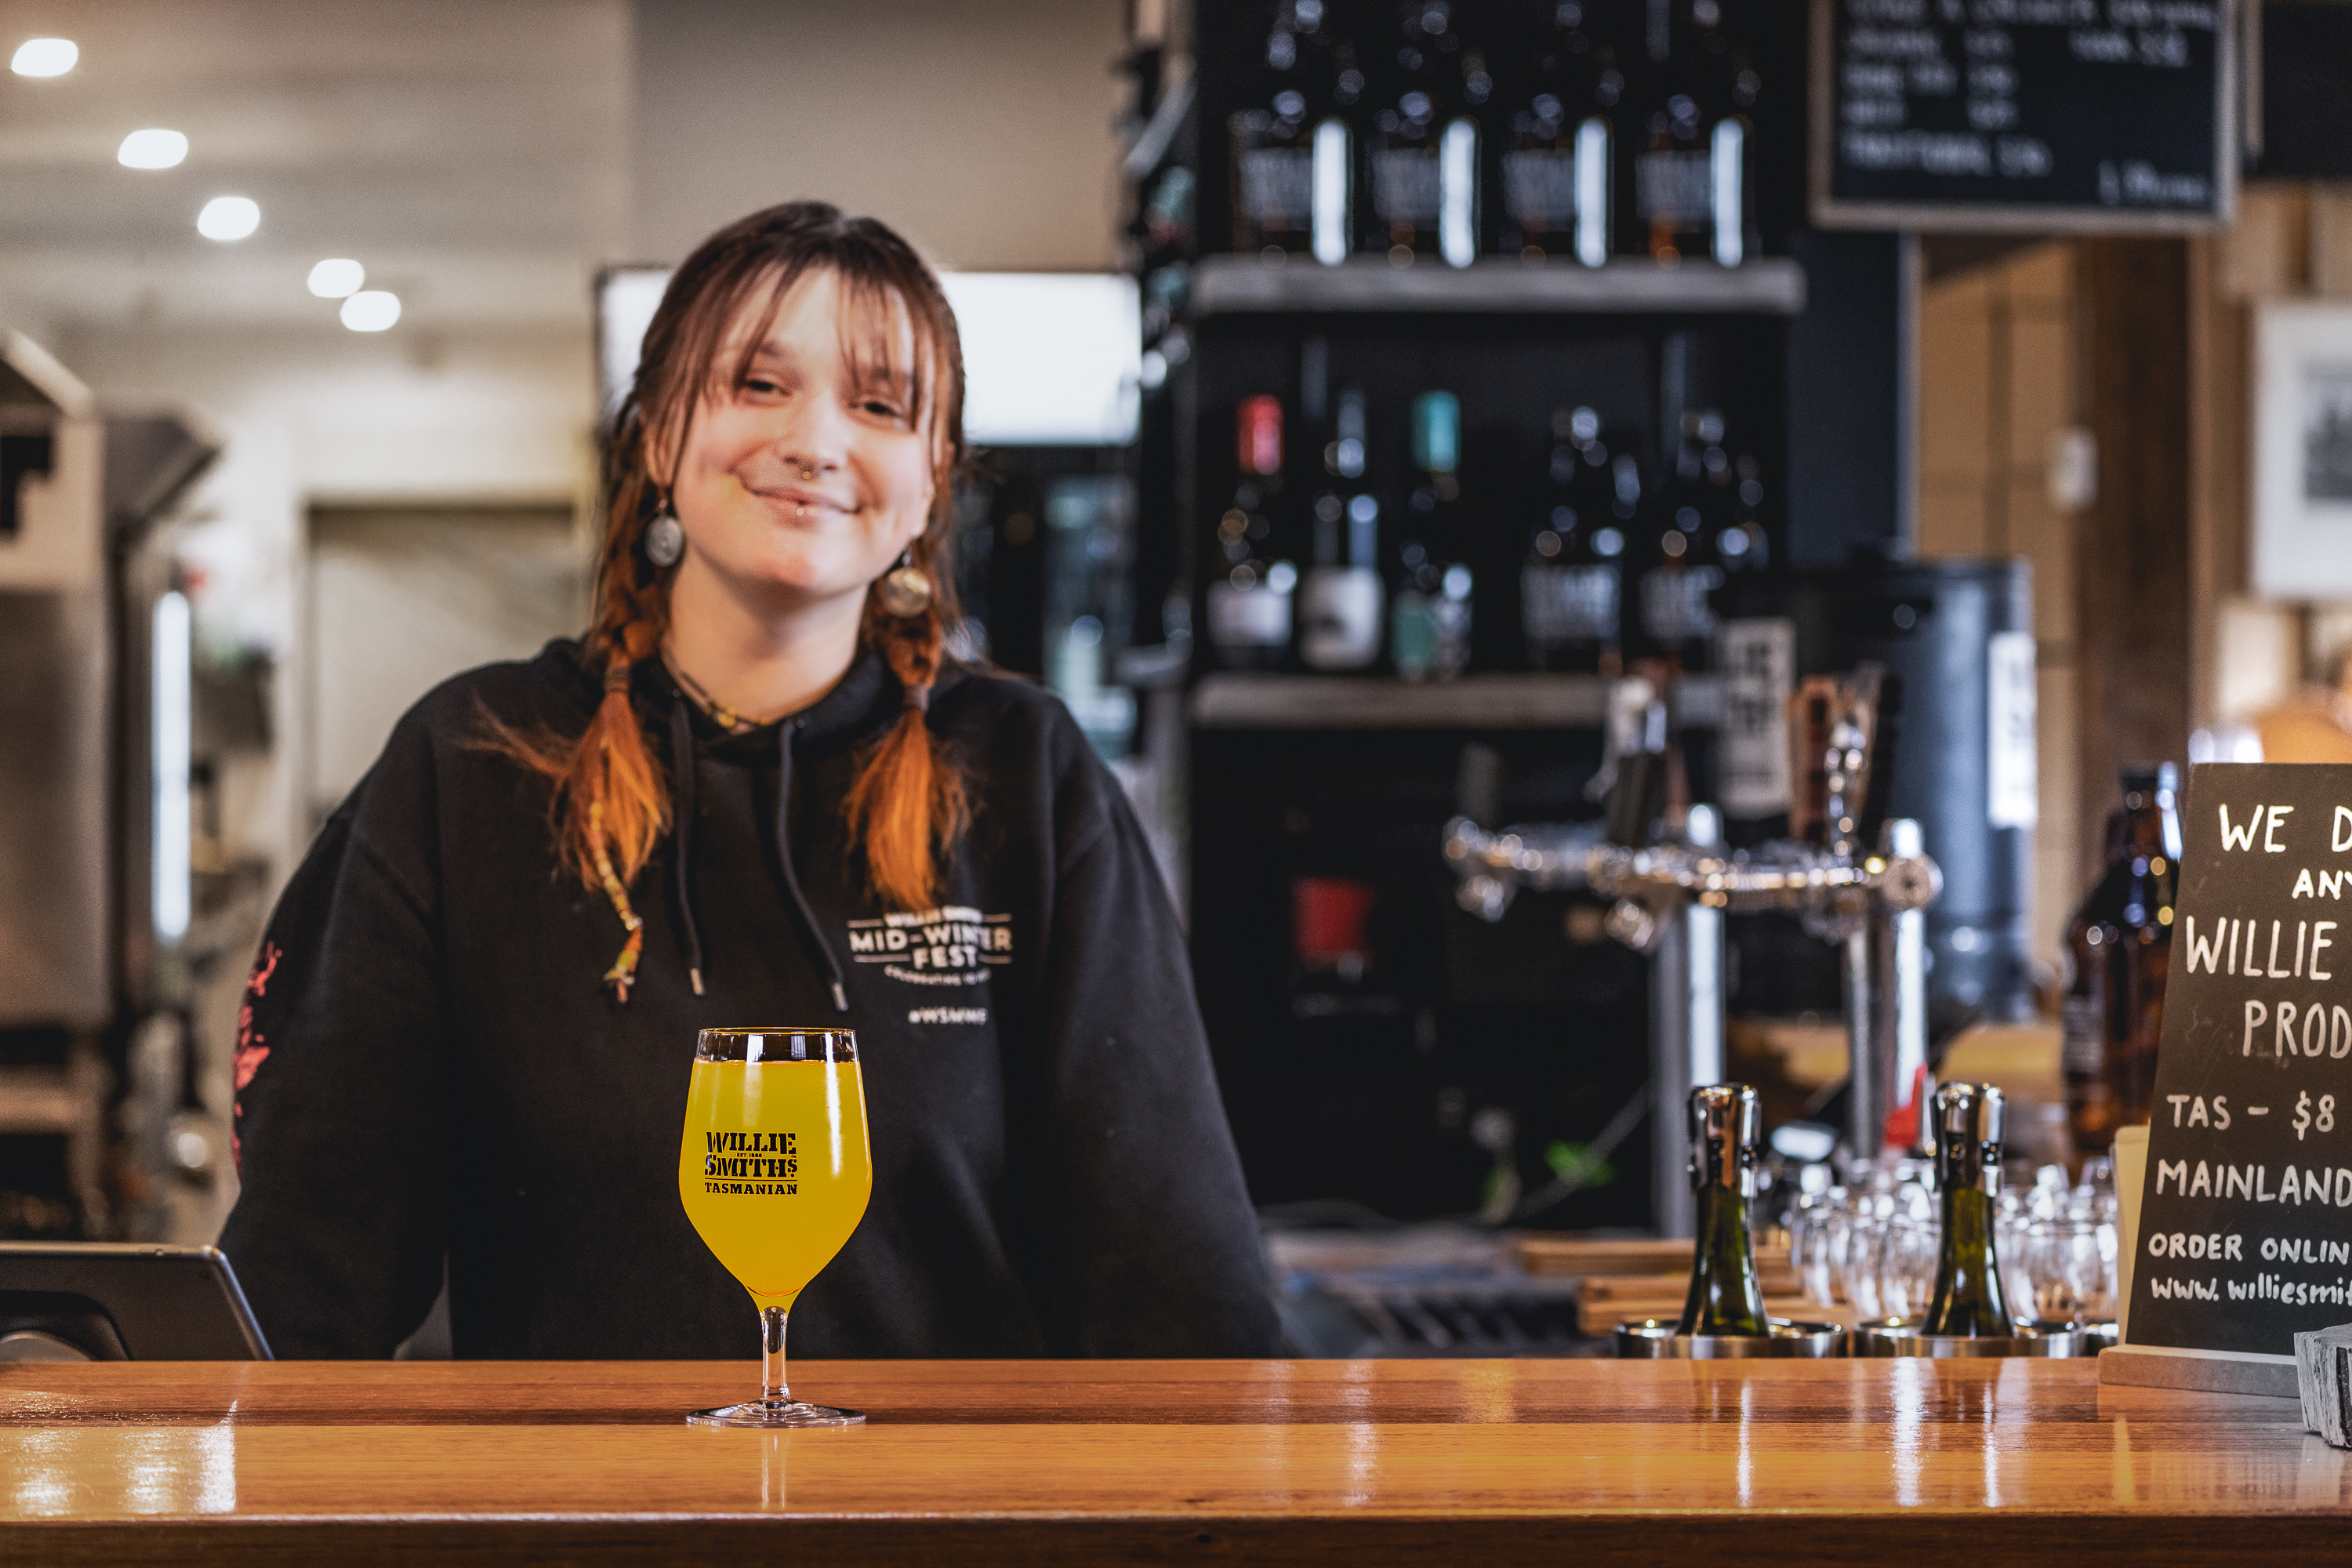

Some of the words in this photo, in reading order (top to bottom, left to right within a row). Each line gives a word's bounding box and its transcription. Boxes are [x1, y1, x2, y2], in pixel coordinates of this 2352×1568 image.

[2218, 803, 2295, 853] WE
[912, 944, 978, 971] FEST
[2186, 915, 2338, 981] WILLIE
[2166, 1094, 2231, 1131] TAS
[2292, 1090, 2336, 1142] $8
[706, 1131, 797, 1155] WILLIE
[704, 1181, 798, 1196] TASMANIAN
[2155, 1159, 2352, 1208] MAINLAND
[2148, 1232, 2243, 1261] ORDER
